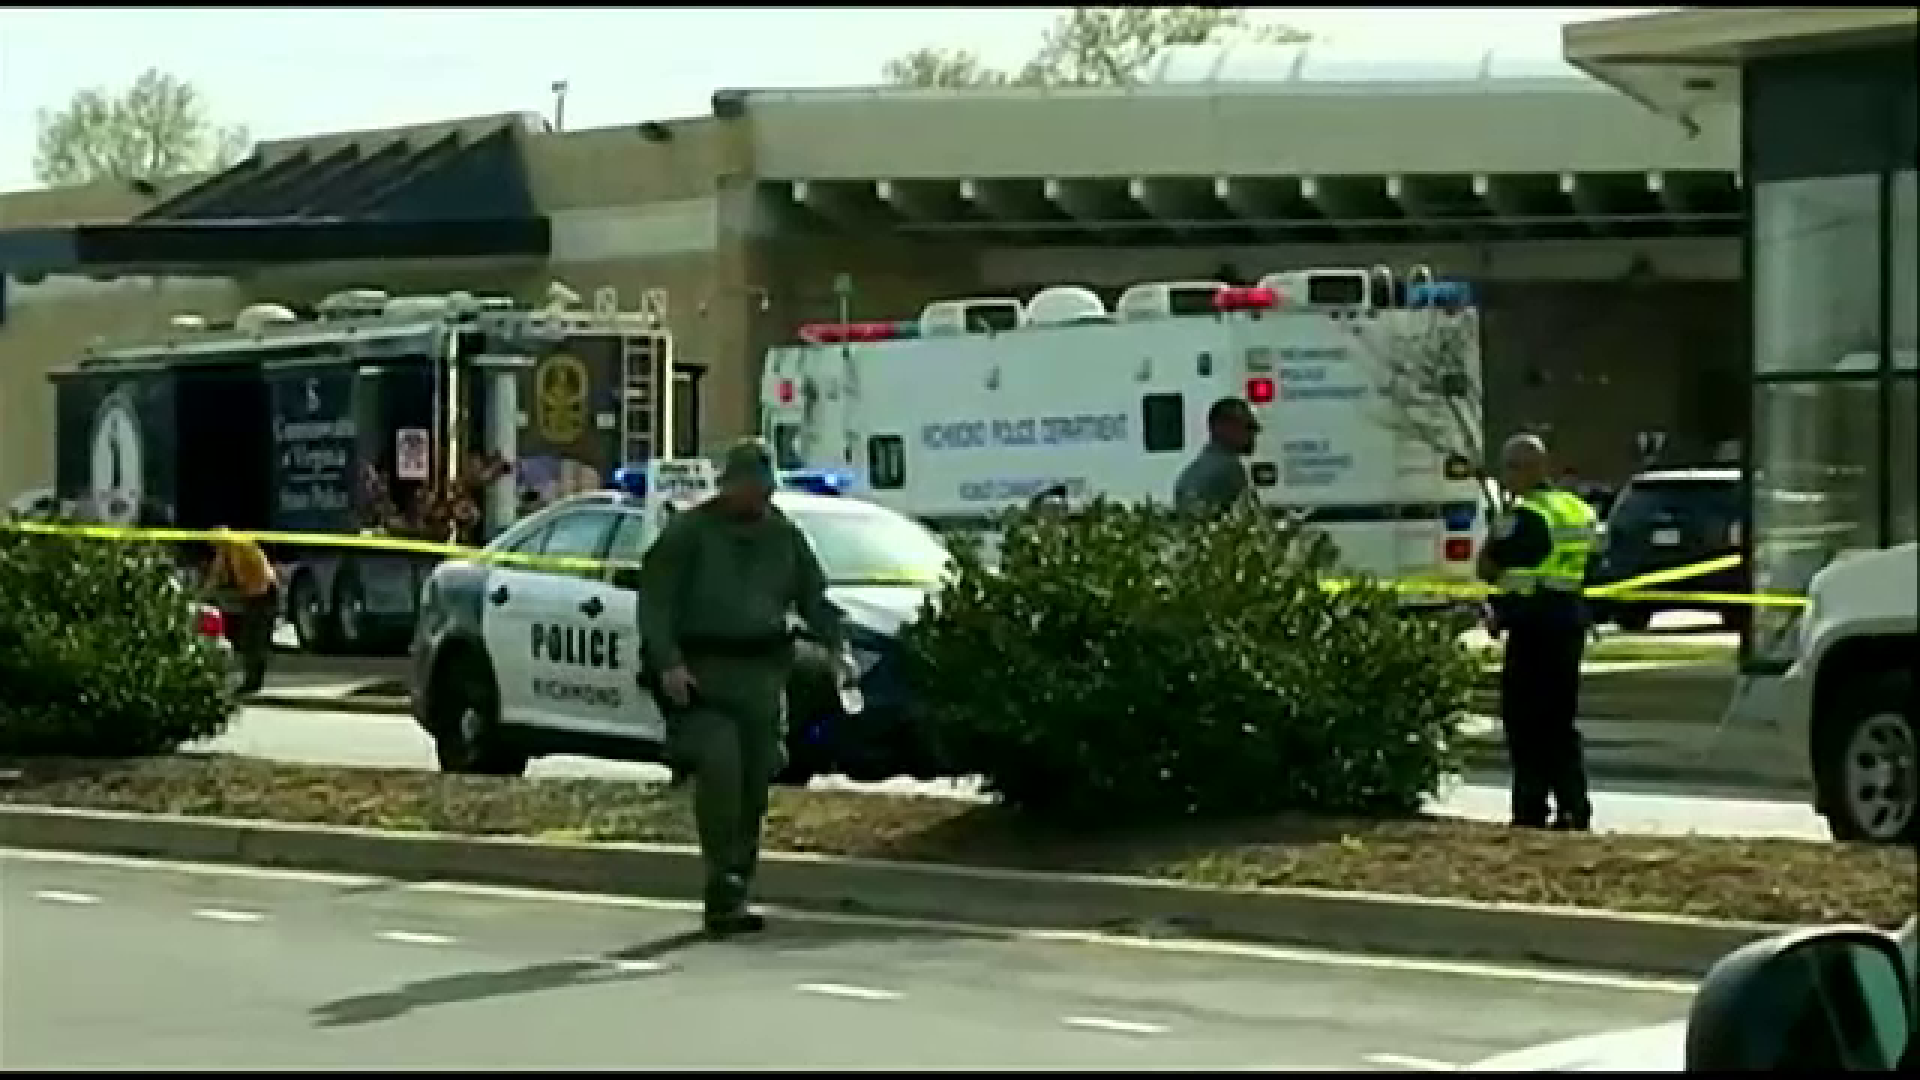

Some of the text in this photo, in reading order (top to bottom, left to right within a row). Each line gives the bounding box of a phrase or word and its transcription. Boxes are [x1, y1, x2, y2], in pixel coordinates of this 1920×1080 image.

[992, 418, 1036, 445] POLICE
[1041, 413, 1128, 444] DEPARTMENT
[531, 622, 620, 669] POLICE
[533, 678, 622, 709] RICHMOND
